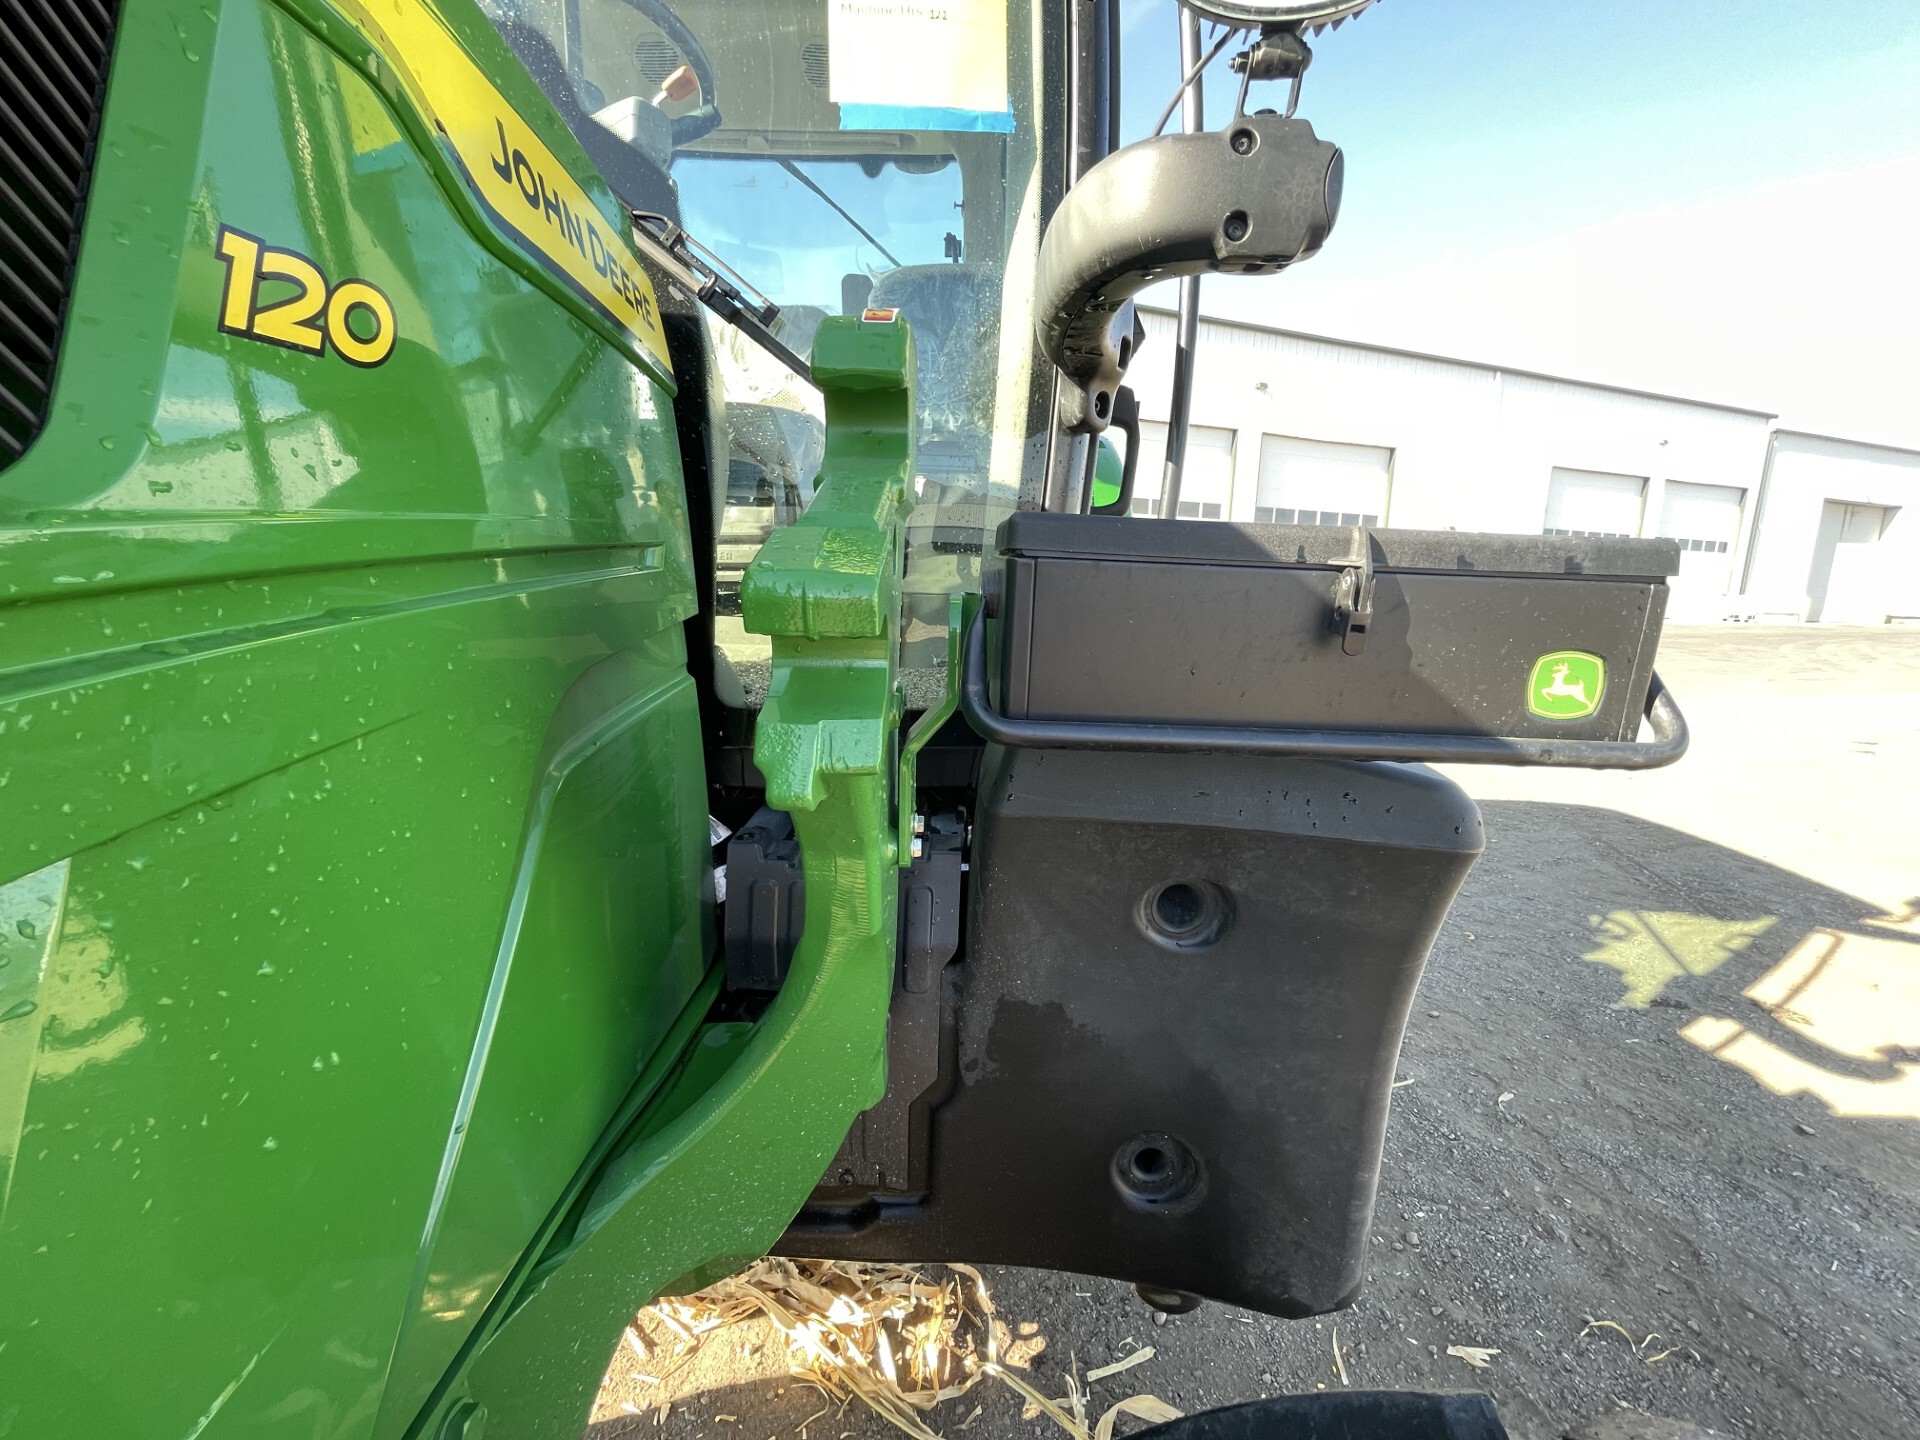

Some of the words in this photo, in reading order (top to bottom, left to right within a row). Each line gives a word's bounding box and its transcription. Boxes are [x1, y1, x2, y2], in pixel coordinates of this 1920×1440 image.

[840, 3, 897, 16] Machine
[928, 8, 948, 21] 121
[214, 222, 398, 369] 120
[490, 116, 587, 261] JOHN
[585, 217, 656, 333] DEERE
